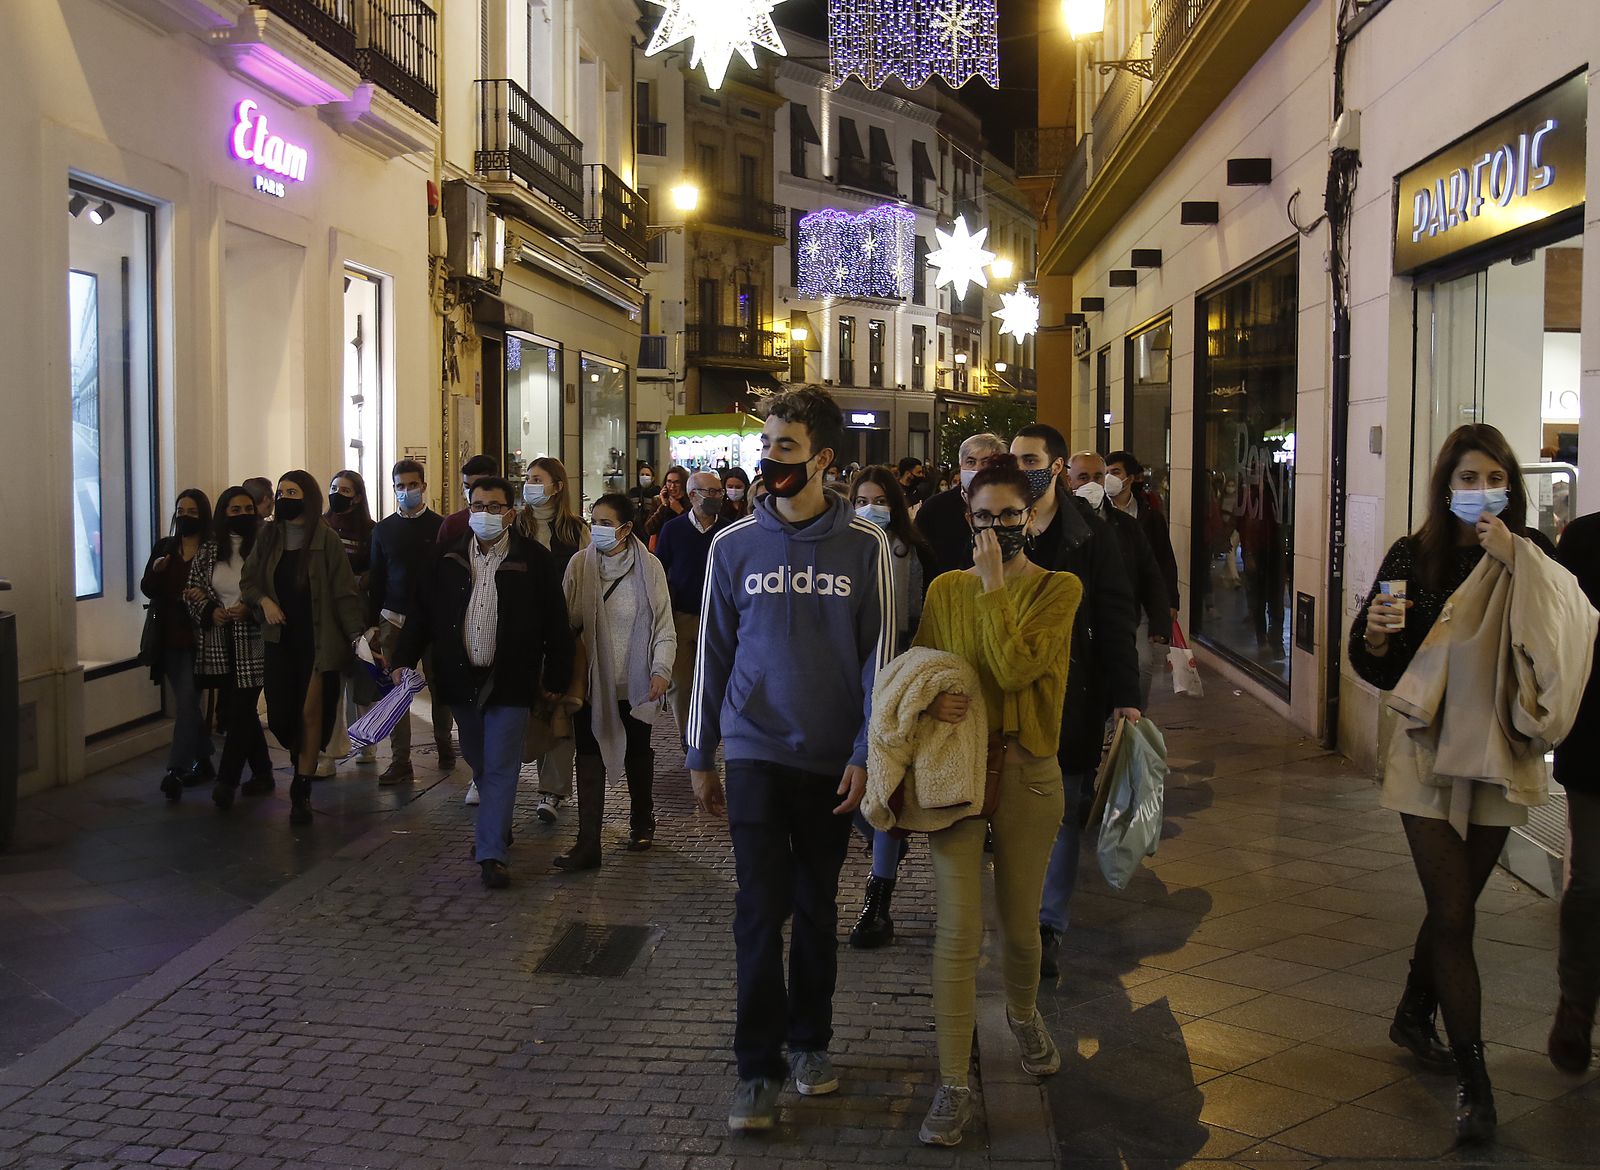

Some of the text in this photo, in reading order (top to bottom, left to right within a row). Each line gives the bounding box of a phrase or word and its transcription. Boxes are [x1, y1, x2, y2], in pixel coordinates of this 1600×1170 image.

[233, 98, 308, 182] Etam
[255, 174, 285, 198] PARIS
[1412, 119, 1556, 243] PARFOIS
[745, 565, 851, 601] adidas
